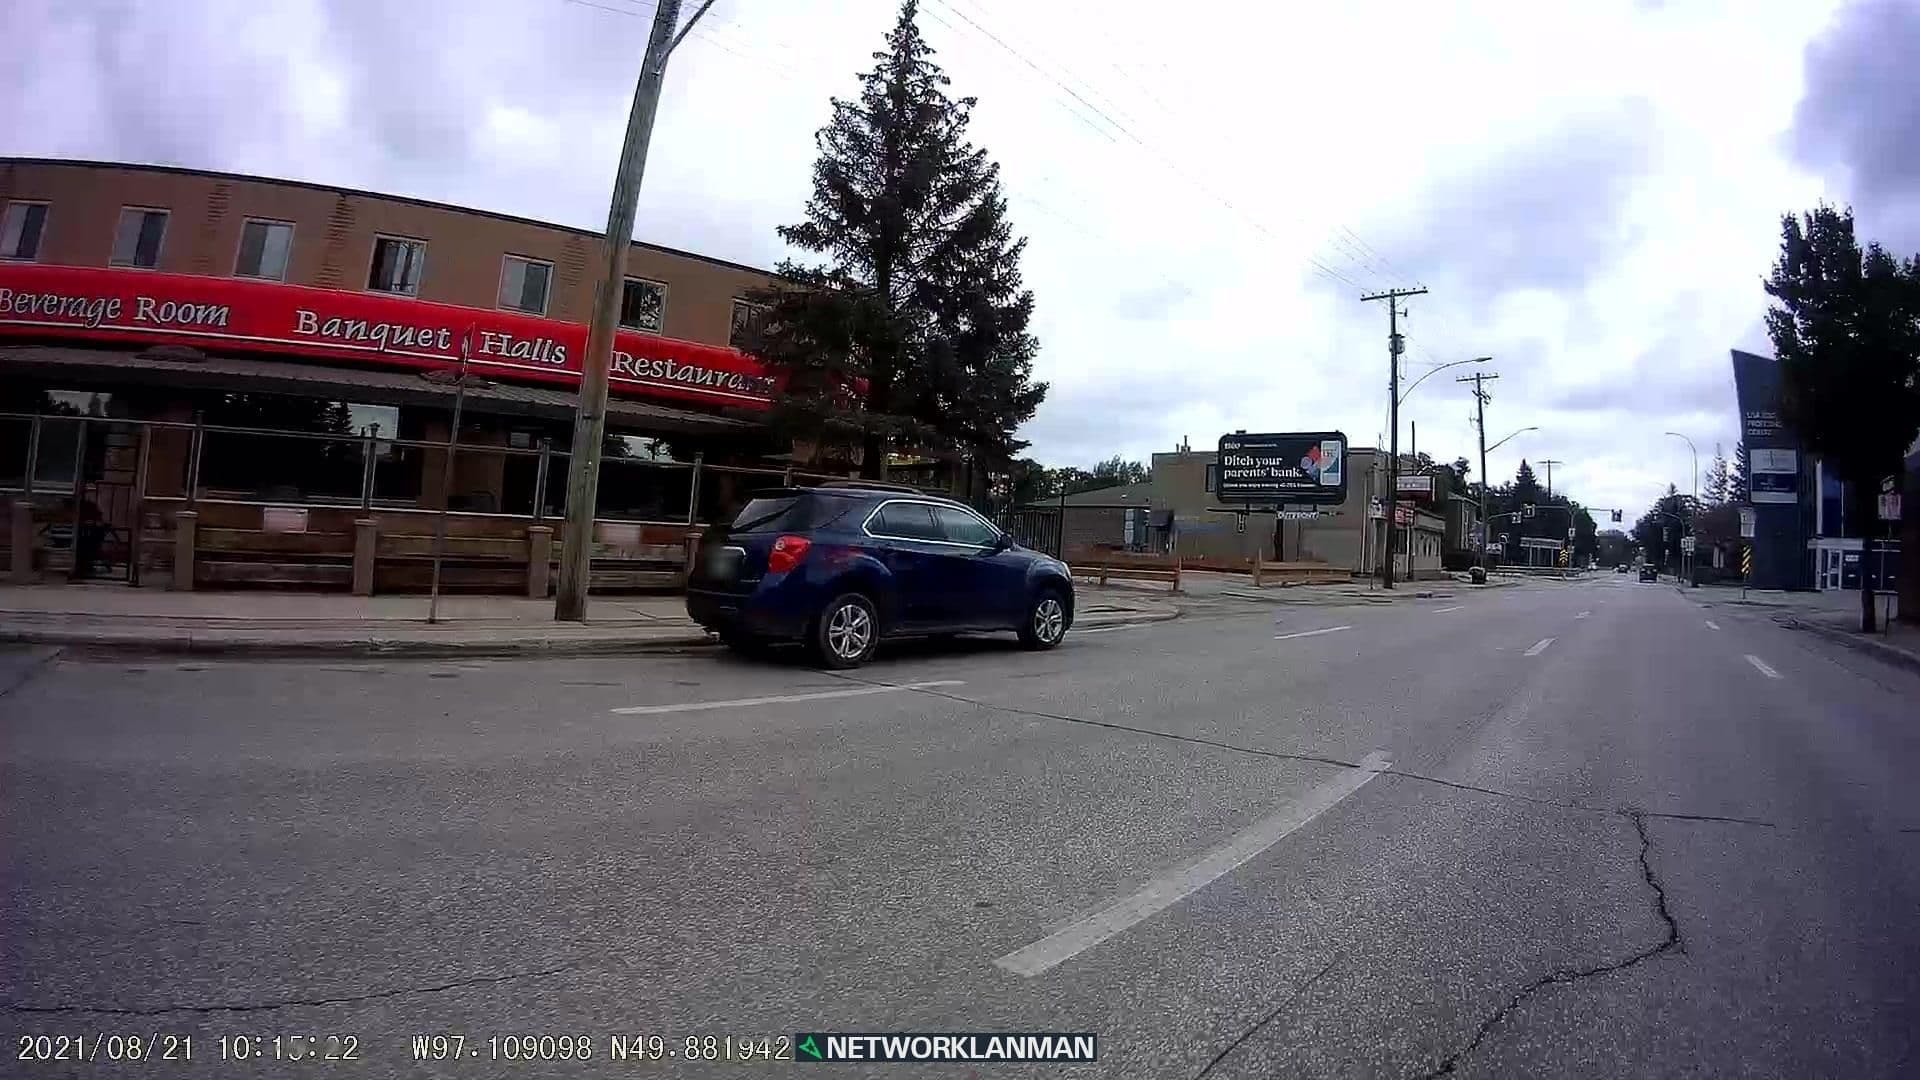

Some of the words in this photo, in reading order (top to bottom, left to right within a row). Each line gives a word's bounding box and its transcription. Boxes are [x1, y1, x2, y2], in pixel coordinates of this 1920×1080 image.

[0, 288, 121, 328] Beverage
[133, 296, 232, 327] Room
[293, 309, 452, 353] Banquet
[479, 331, 568, 364] Halls
[1223, 455, 1254, 466] Ditch
[1255, 457, 1283, 468] your
[1271, 467, 1303, 478] bank.
